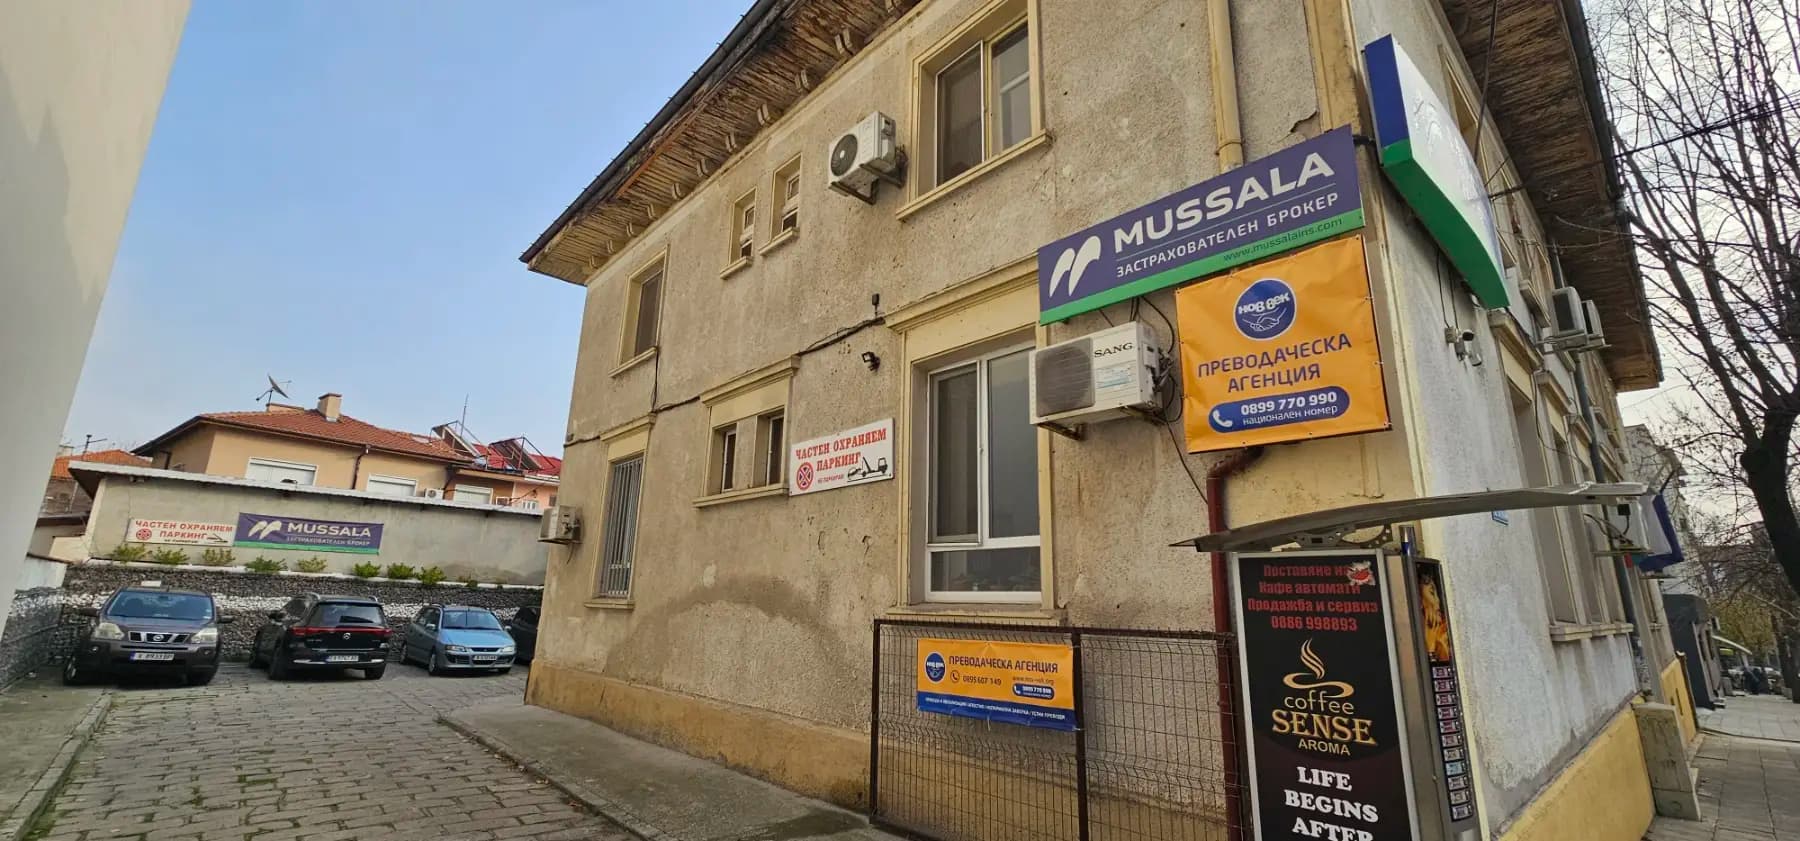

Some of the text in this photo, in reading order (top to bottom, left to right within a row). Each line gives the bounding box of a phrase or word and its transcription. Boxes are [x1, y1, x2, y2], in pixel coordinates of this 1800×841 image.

[1114, 151, 1335, 254] MUSSALA
[1116, 192, 1339, 278] ЗАСТРАХОВАТЕЛЕН БРОКЕР
[1223, 218, 1343, 262] www.mussalains.com
[1094, 342, 1134, 358] SANG
[1198, 333, 1352, 378] ПРЕВОДАЧЕСКА
[1227, 363, 1321, 393] АГЕНЦИЯ
[1241, 391, 1338, 416] 0899 770 990
[1242, 404, 1338, 425] национален номер
[795, 428, 887, 460] ЧАСТЕН ОХРАНЯЕМ
[816, 452, 861, 472] ПАРКИНГ
[135, 520, 233, 532] ЧАСТЕН ОХРАНЯЕМ
[159, 530, 207, 540] ПАРКИНГ
[287, 522, 371, 537] MUSSALA
[1264, 564, 1332, 577] Поставяне
[1259, 581, 1361, 595] Кафе автомати
[1247, 598, 1378, 614] Продажба и сервиз
[1271, 615, 1358, 631] 0886 998893
[949, 656, 1058, 673] ПРЕВОДАЧЕСКА АГЕНЦИЯ
[1284, 690, 1355, 715] coffee
[1271, 709, 1378, 746] SENSE
[1298, 737, 1351, 756] AROMA
[1296, 766, 1353, 792] LIFE
[1284, 789, 1379, 823] BEGINS
